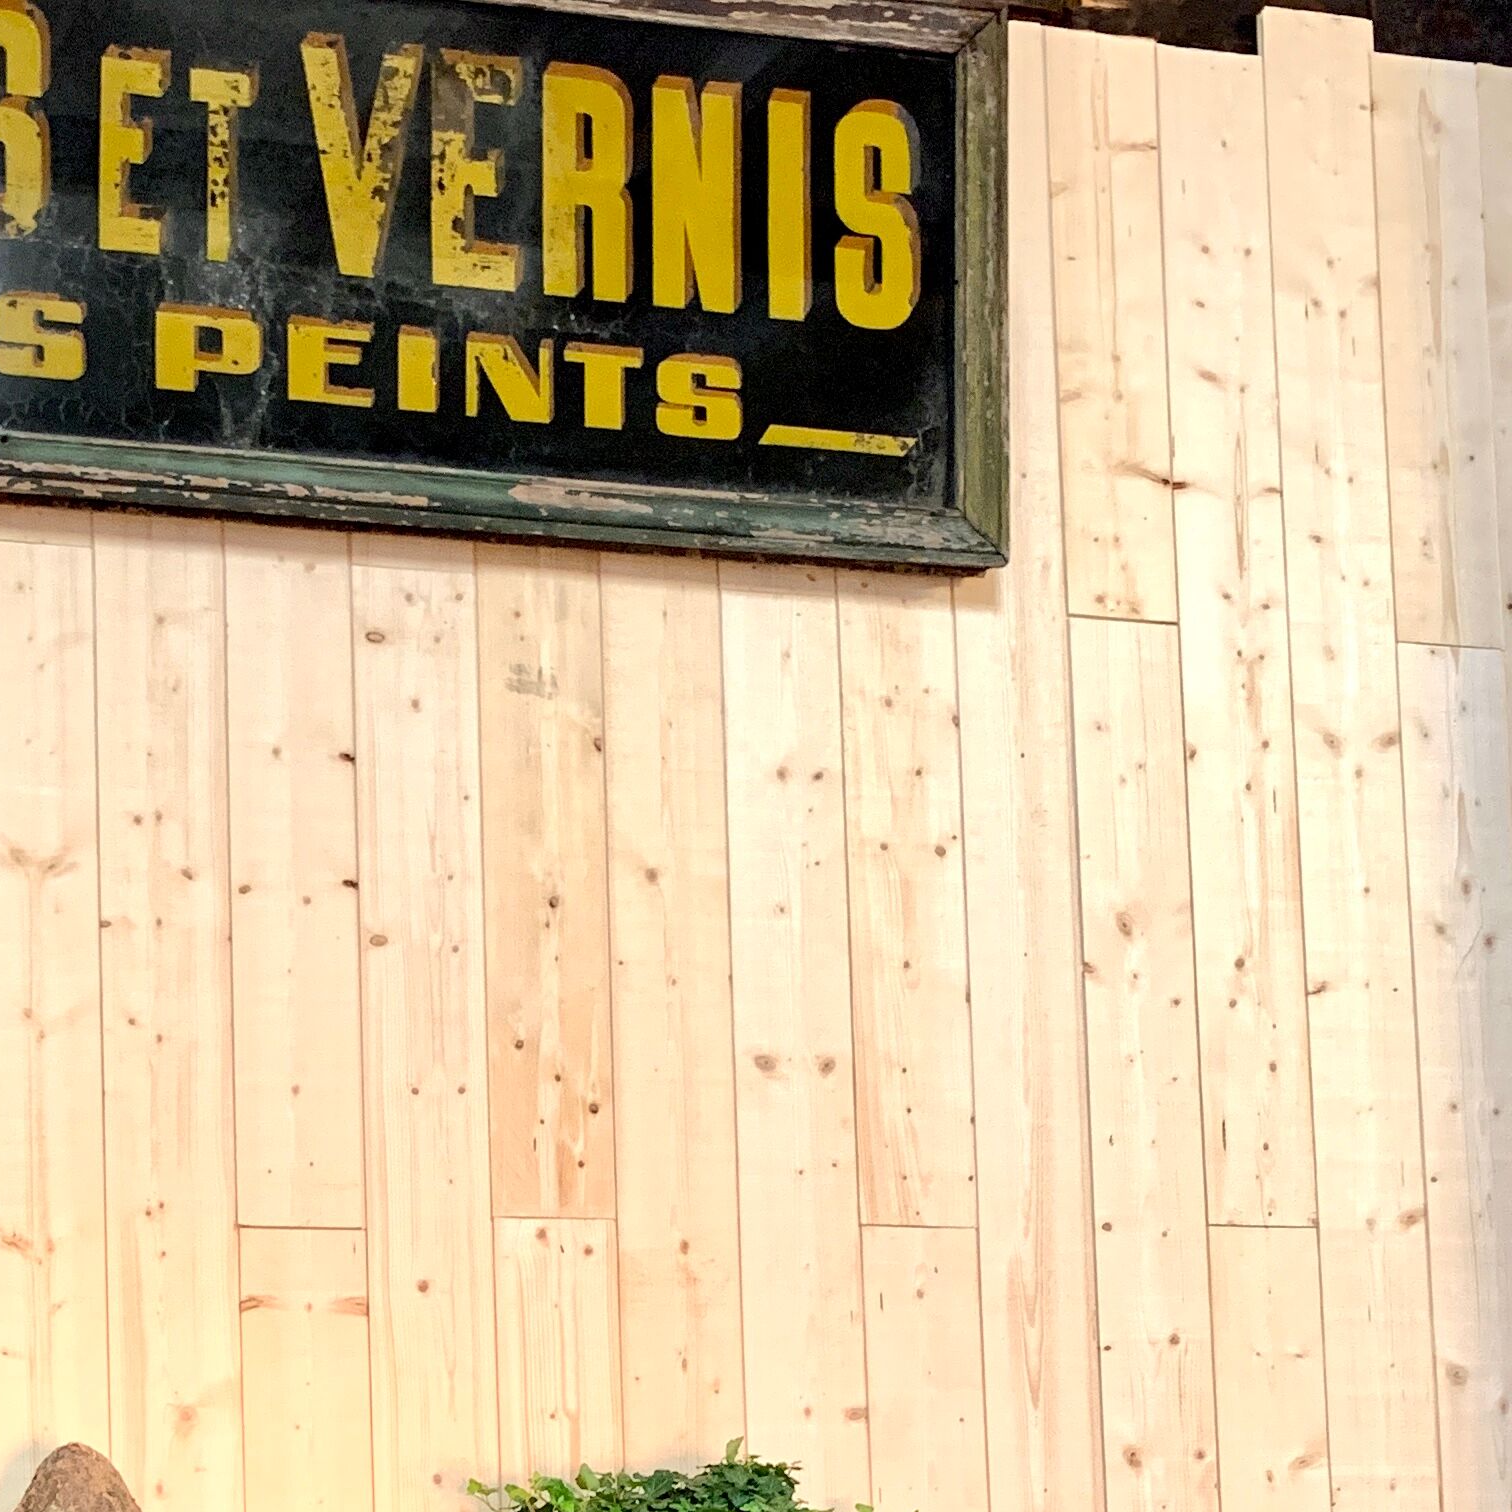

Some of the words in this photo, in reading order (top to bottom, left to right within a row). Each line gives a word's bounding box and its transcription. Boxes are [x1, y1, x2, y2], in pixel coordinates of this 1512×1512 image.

[99, 42, 258, 263] ET
[300, 32, 921, 330] VERNIS
[154, 302, 743, 440] PEINTS
